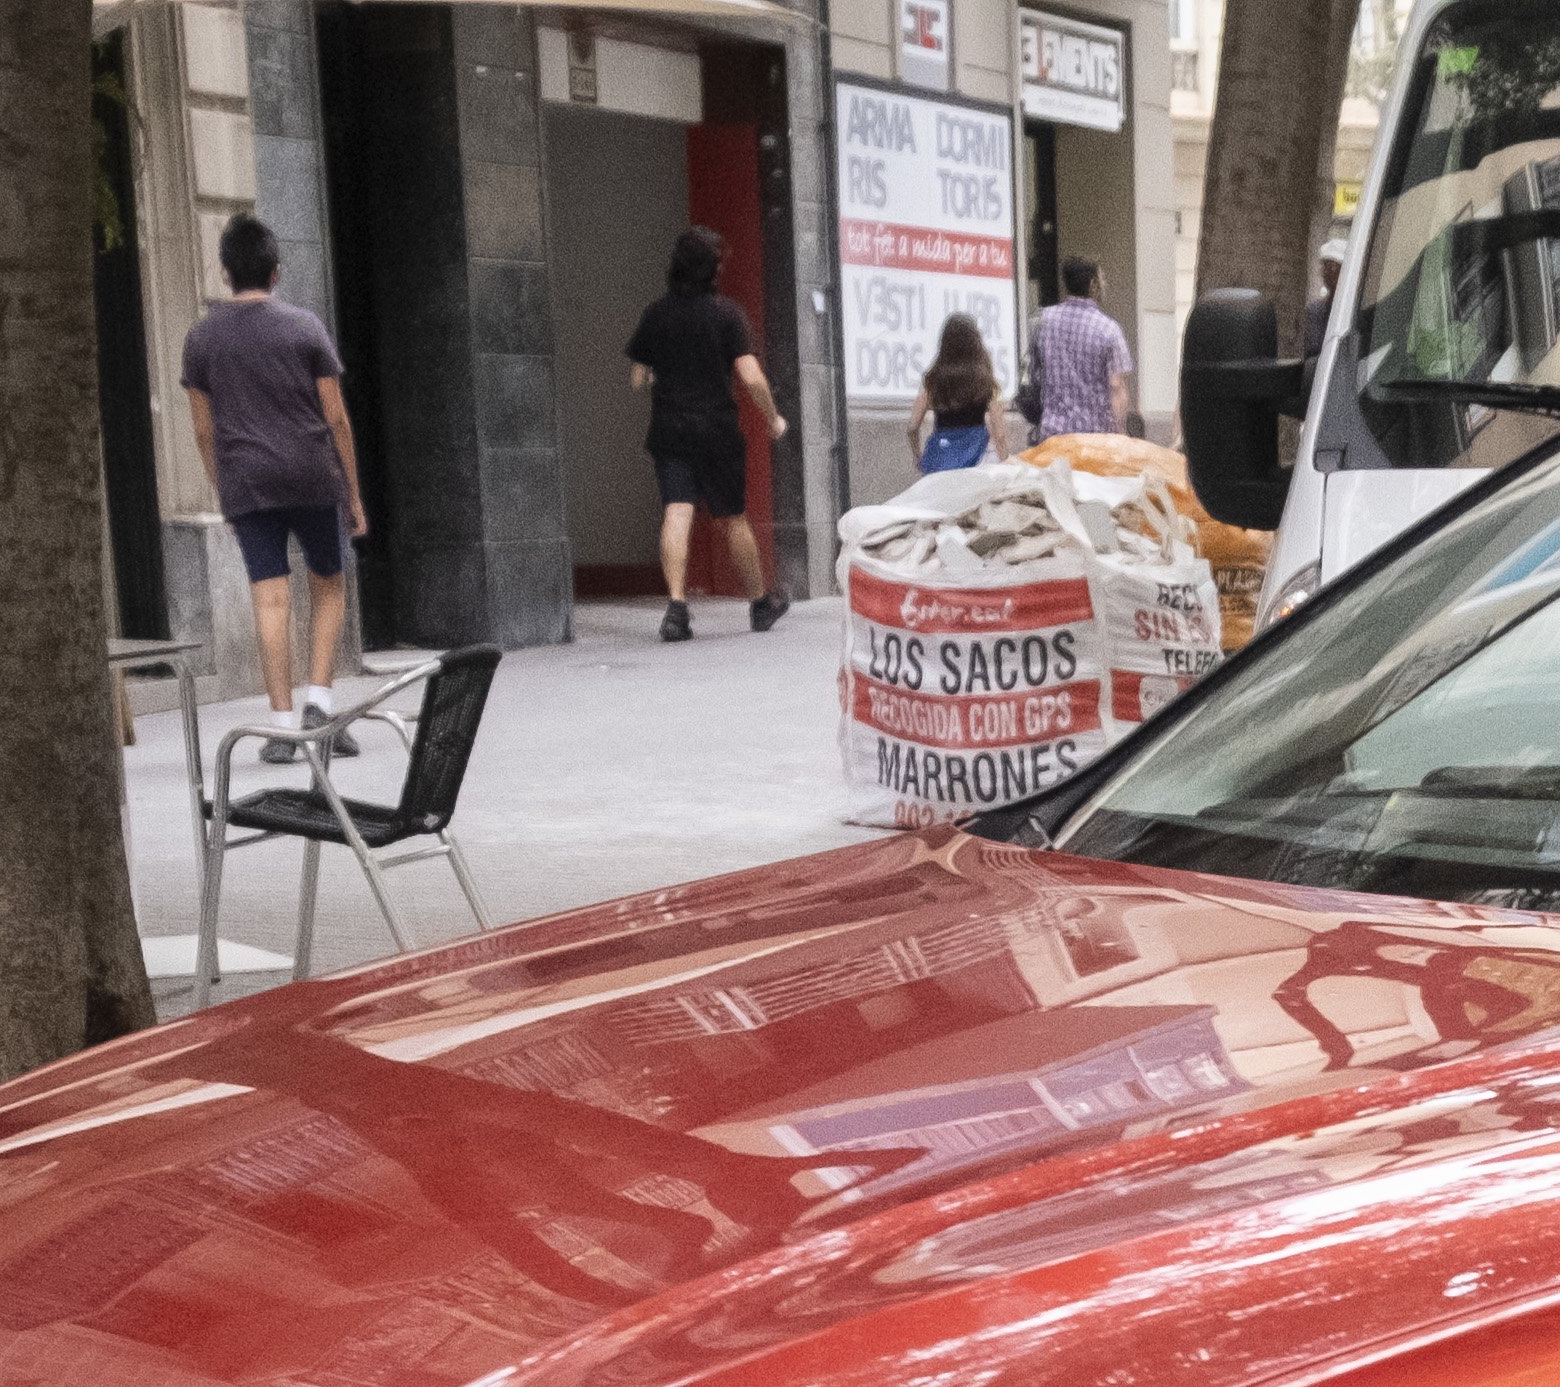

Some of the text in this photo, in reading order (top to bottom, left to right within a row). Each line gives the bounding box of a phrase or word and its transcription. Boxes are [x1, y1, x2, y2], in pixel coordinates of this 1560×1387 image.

[846, 94, 917, 154] ARMA
[936, 112, 1005, 170] DORMI
[847, 155, 888, 210] RIS
[937, 168, 1003, 221] TORIS
[873, 223, 896, 264] fet
[898, 235, 909, 257] a
[912, 231, 951, 260] mida
[954, 242, 977, 273] per
[979, 243, 989, 265] a
[855, 337, 924, 388] DORS
[1134, 608, 1181, 641] SIN
[869, 627, 1077, 694] LOS SACOS
[868, 687, 1072, 742] RECOGIDA CON GPS
[877, 736, 1078, 803] MARRONES
